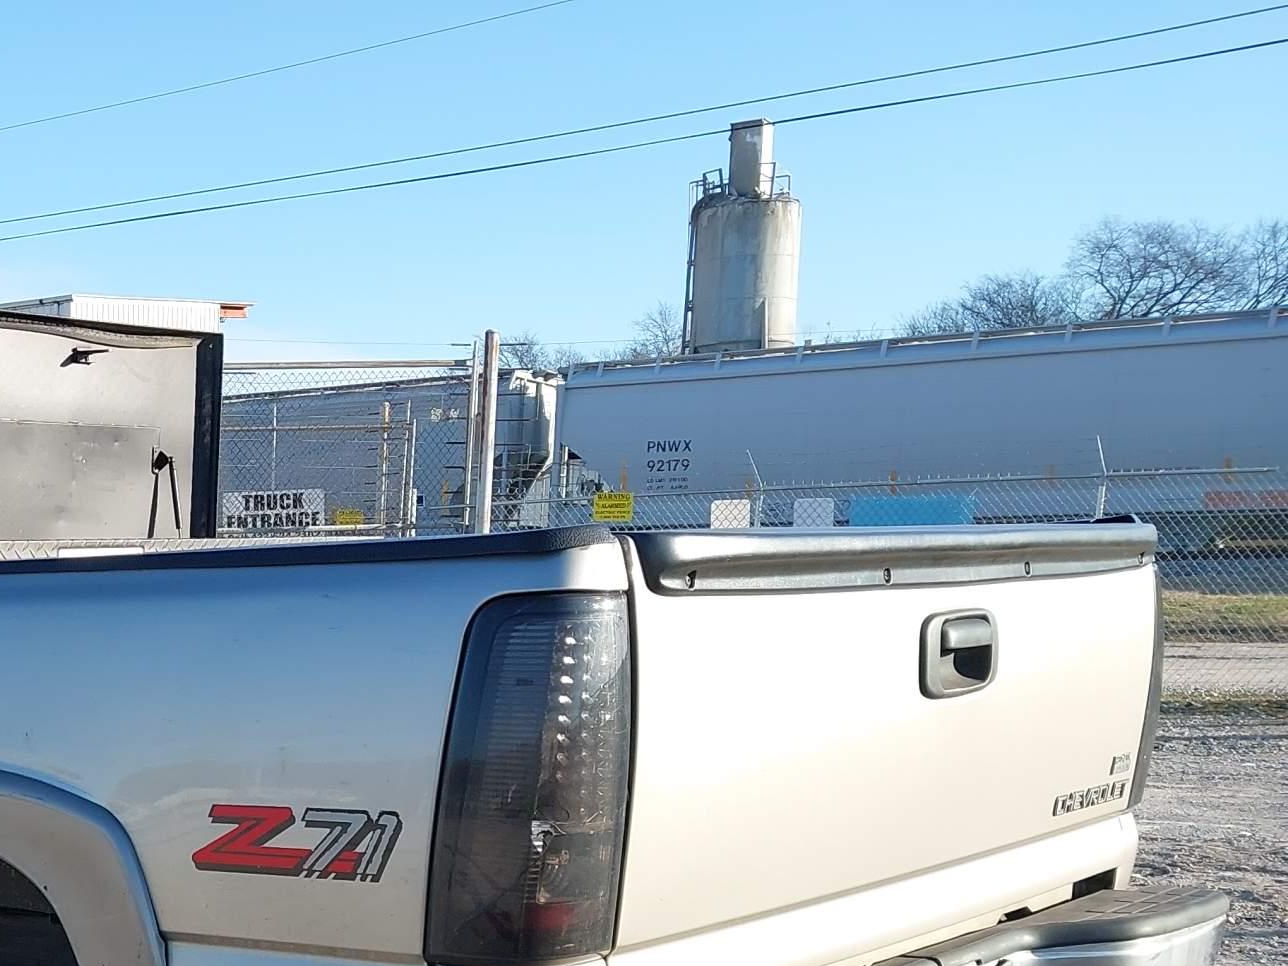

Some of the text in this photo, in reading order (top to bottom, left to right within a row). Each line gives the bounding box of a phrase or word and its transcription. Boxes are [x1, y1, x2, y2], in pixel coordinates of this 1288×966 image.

[647, 439, 692, 453] PNWX
[647, 458, 690, 472] 92179
[242, 493, 305, 511] TRUCK
[227, 511, 321, 528] ENTRANCE
[1053, 779, 1130, 817] CHEVROLET
[192, 804, 403, 883] Z71
